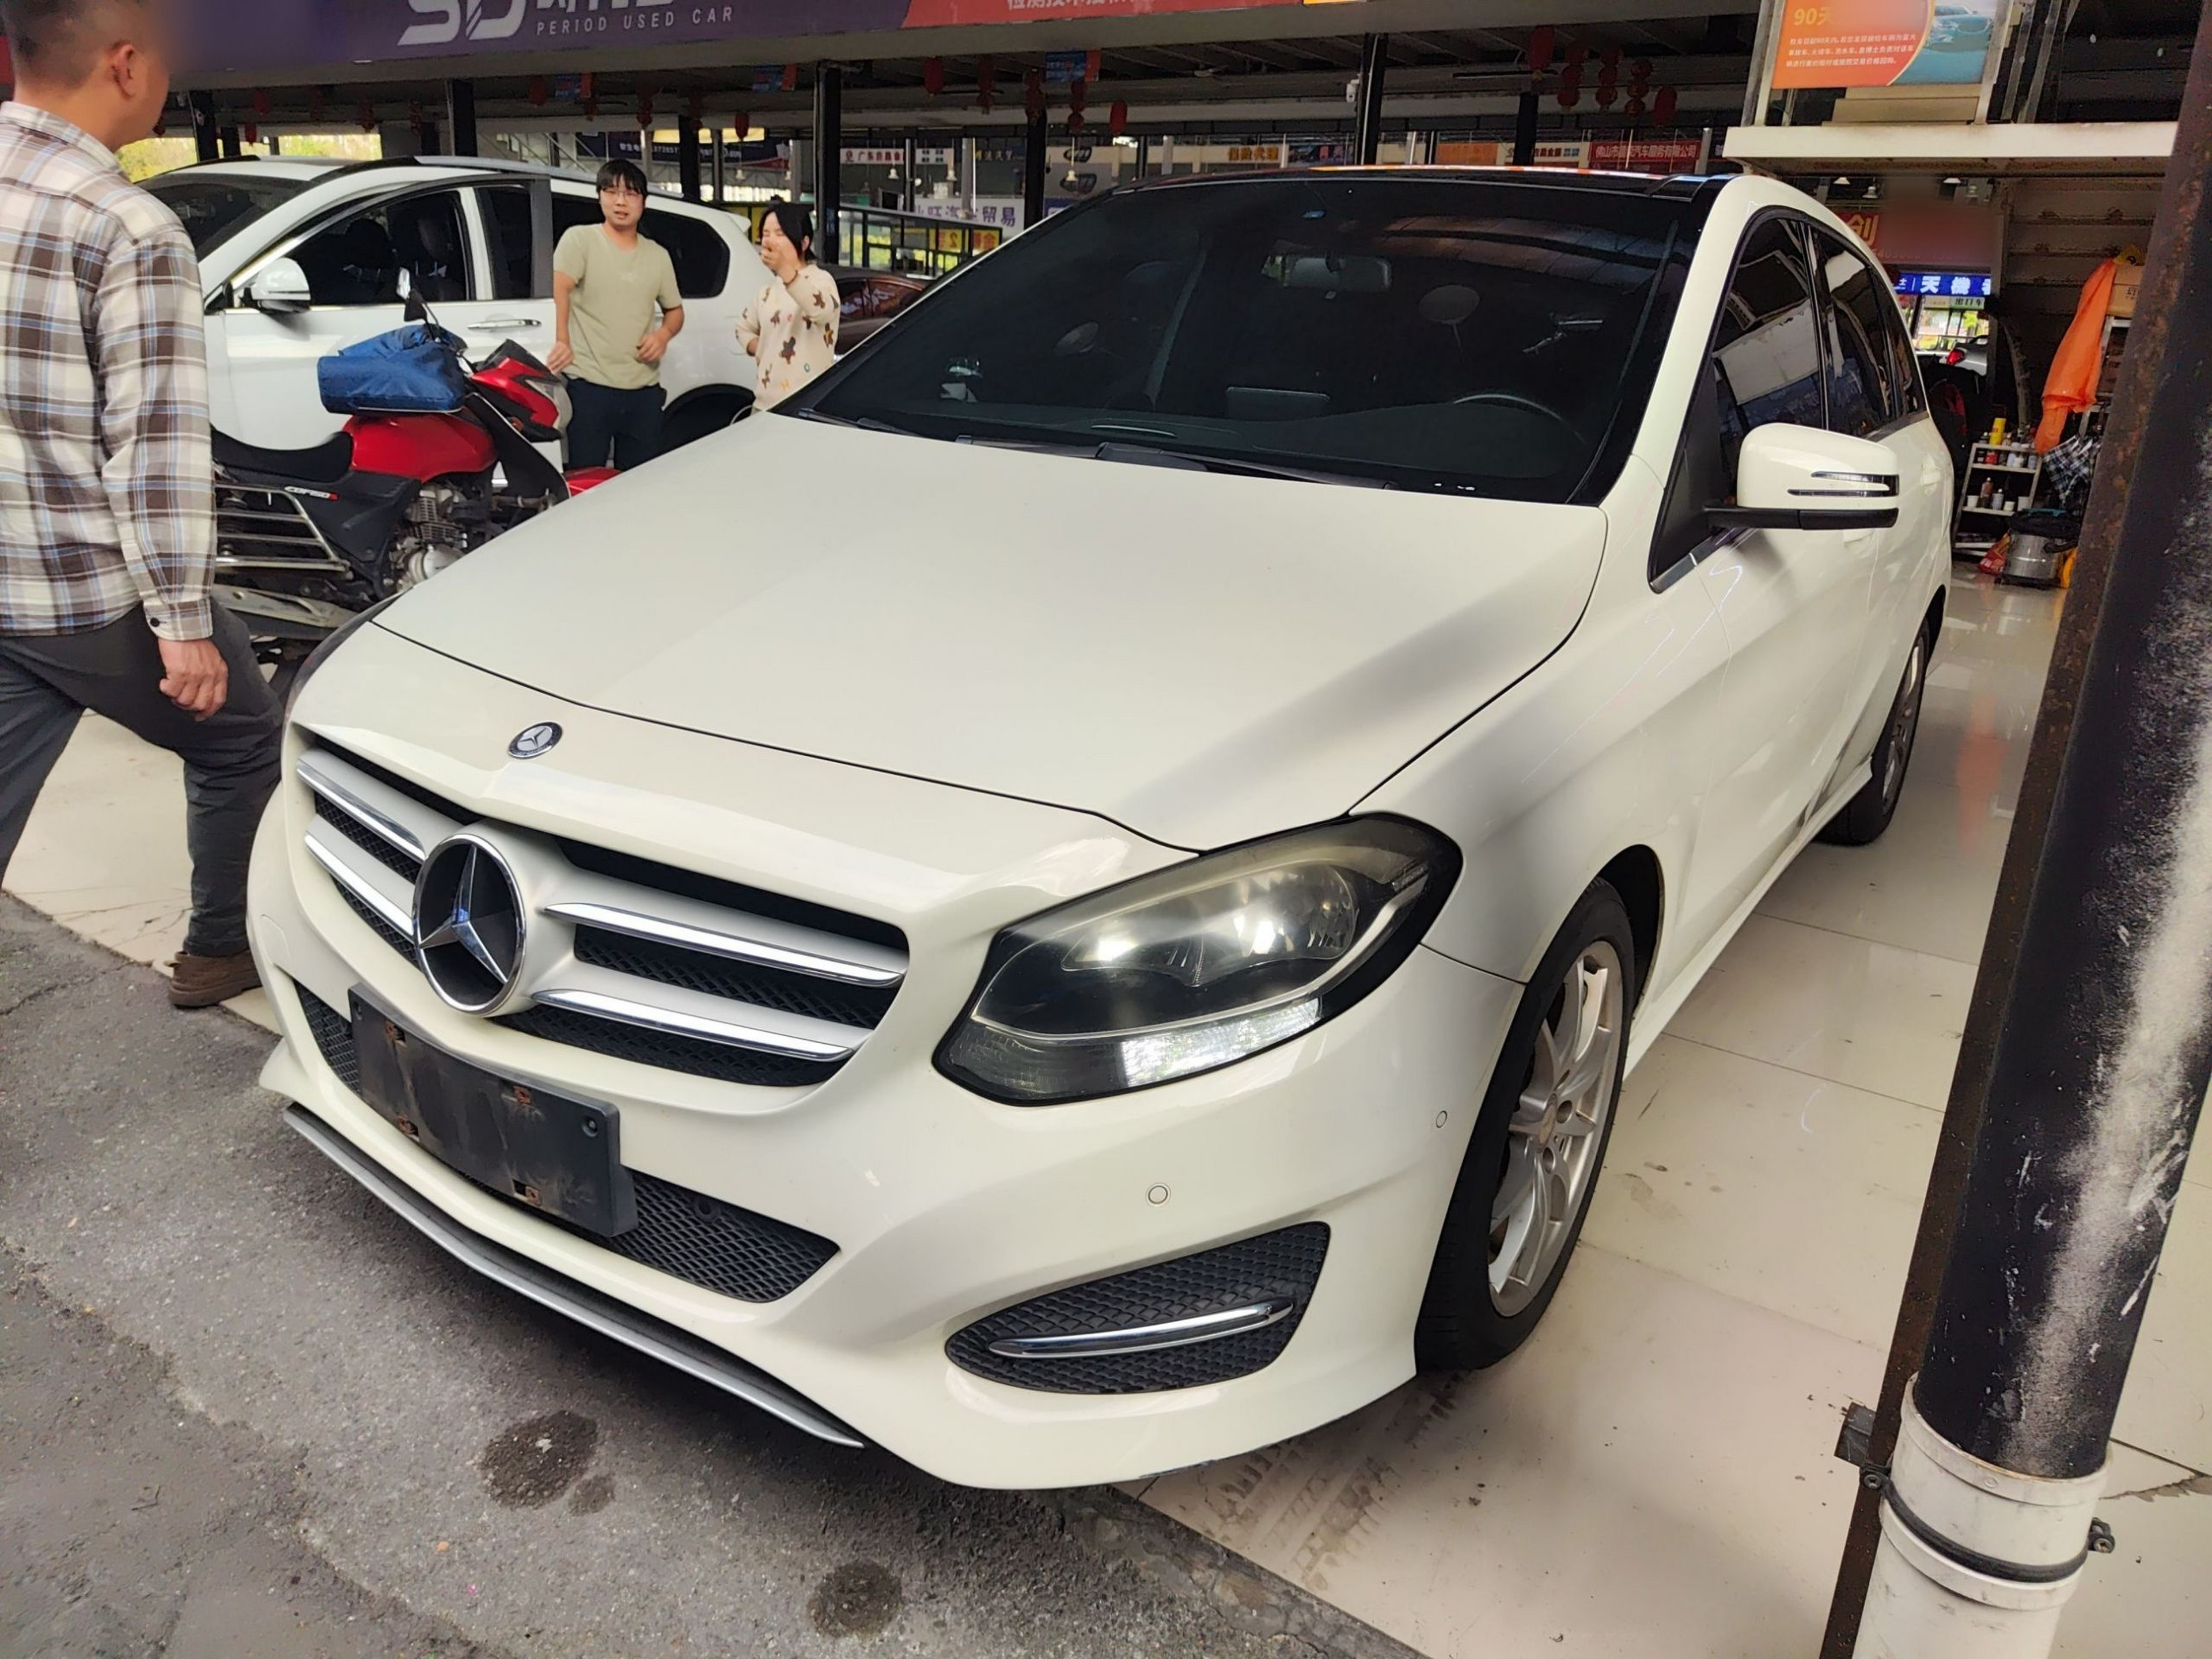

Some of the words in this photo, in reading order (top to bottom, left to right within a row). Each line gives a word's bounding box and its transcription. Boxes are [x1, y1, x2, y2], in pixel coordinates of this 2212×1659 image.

[537, 17, 607, 35] PERIOD
[623, 12, 674, 29] USED
[692, 7, 732, 24] CAR
